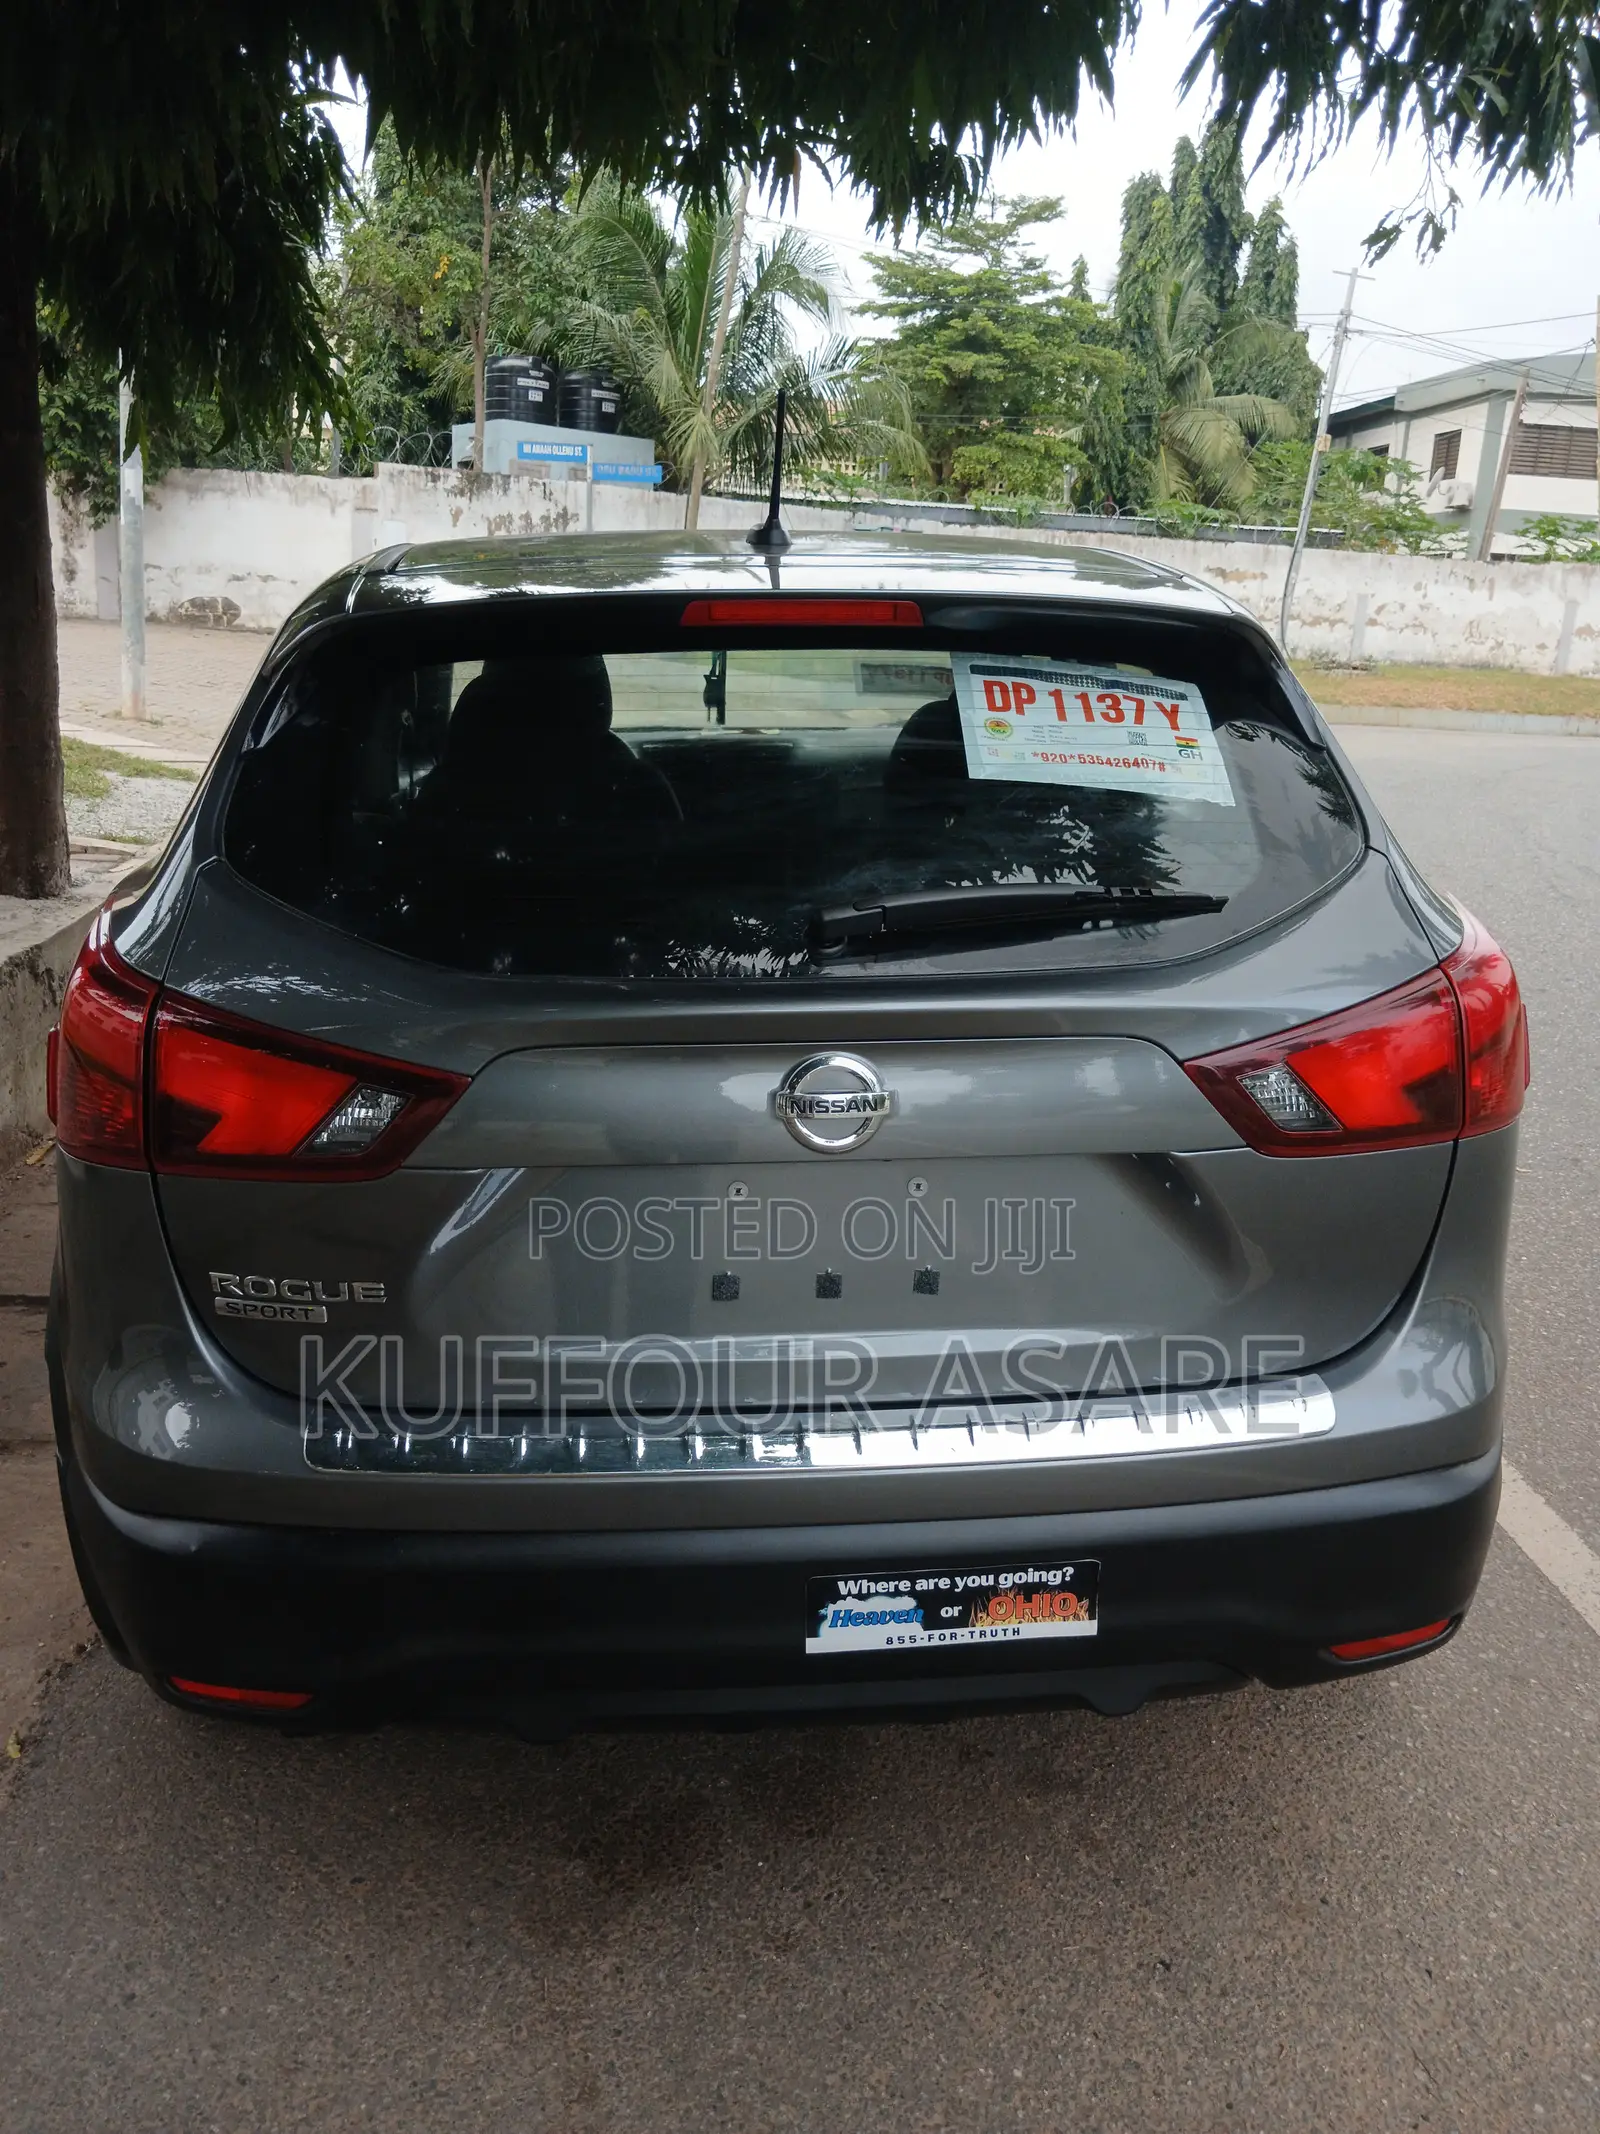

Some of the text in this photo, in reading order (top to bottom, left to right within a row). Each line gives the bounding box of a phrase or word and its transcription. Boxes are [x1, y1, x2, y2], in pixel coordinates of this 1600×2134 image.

[984, 680, 1180, 731] DP 1137 Y
[1178, 749, 1203, 761] GH
[790, 1098, 878, 1114] NISSAN
[208, 1271, 388, 1304] ROGUE
[225, 1301, 315, 1321] SPORT
[837, 1566, 1075, 1596] Where are you going?
[828, 1591, 1079, 1629] Heaven or OHIO
[885, 1627, 1021, 1646] 855-FOR-TRUTH
